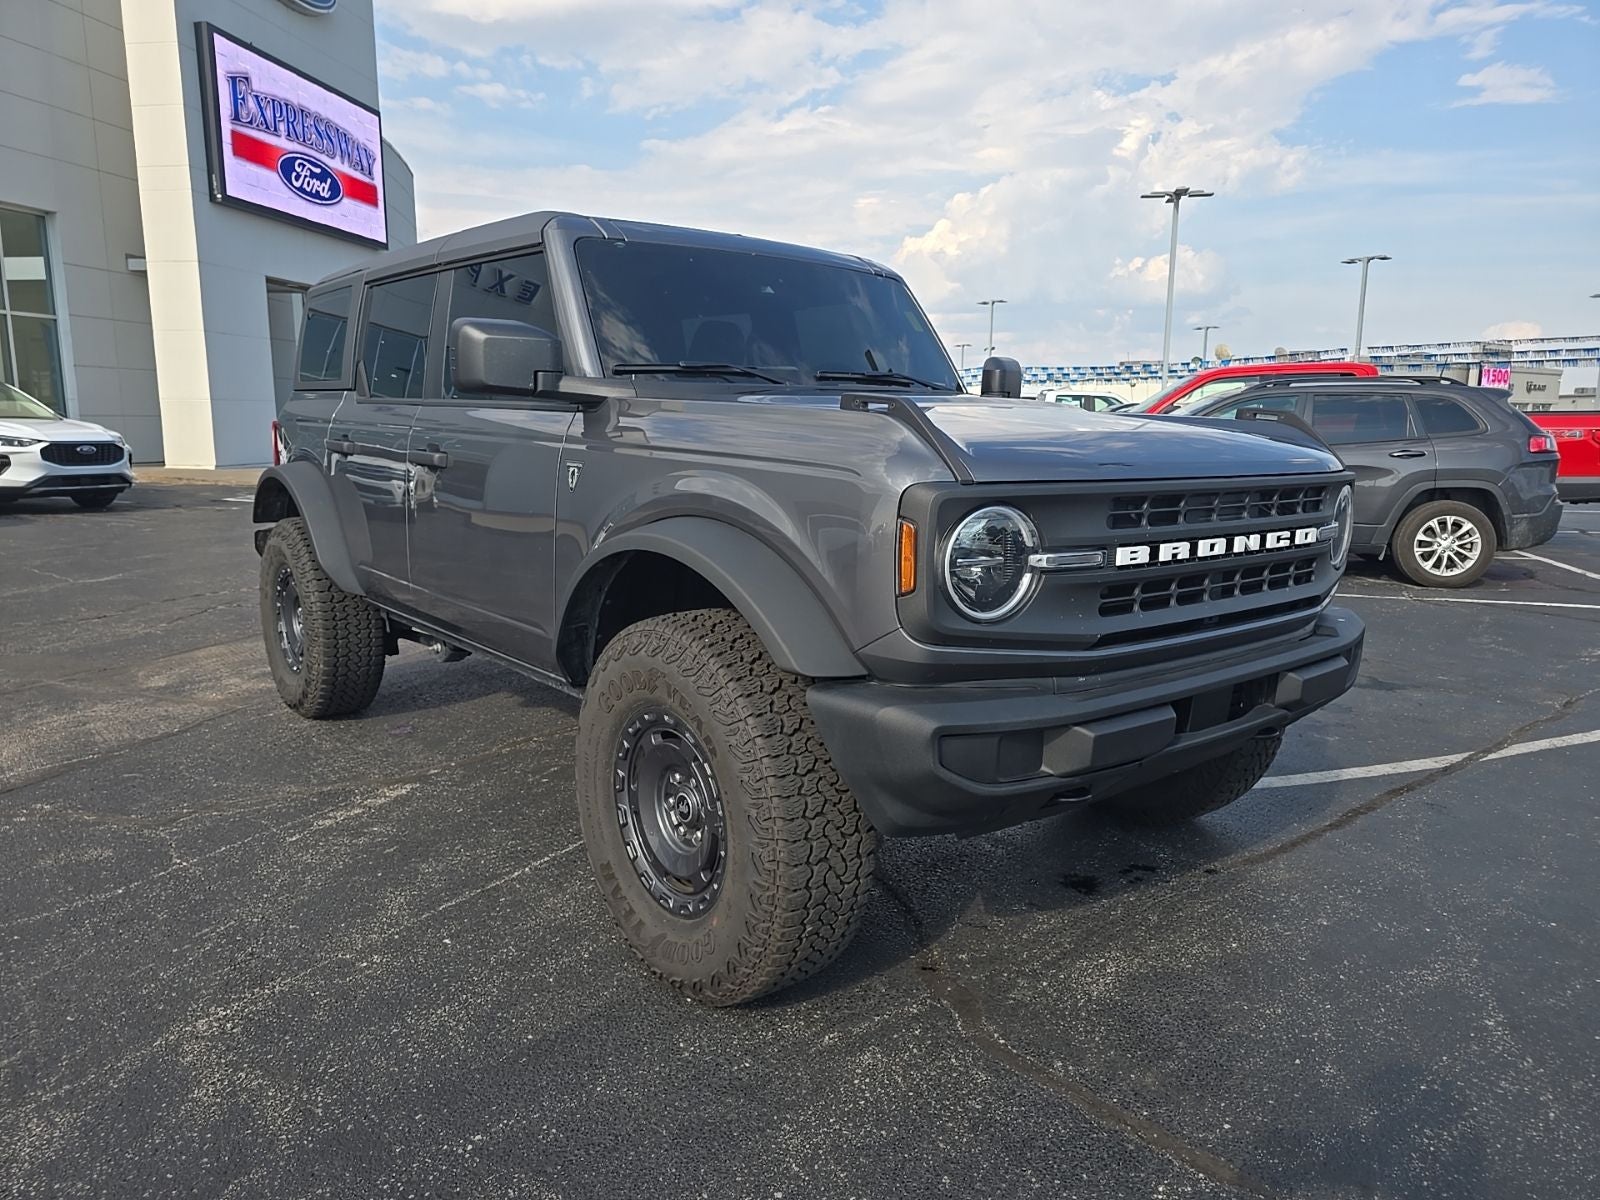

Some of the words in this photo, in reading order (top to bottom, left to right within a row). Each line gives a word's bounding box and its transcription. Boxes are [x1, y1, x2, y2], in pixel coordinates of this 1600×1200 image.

[226, 73, 376, 180] EXPRESSWAY
[291, 159, 332, 199] Ford
[1115, 527, 1318, 566] BRONCO
